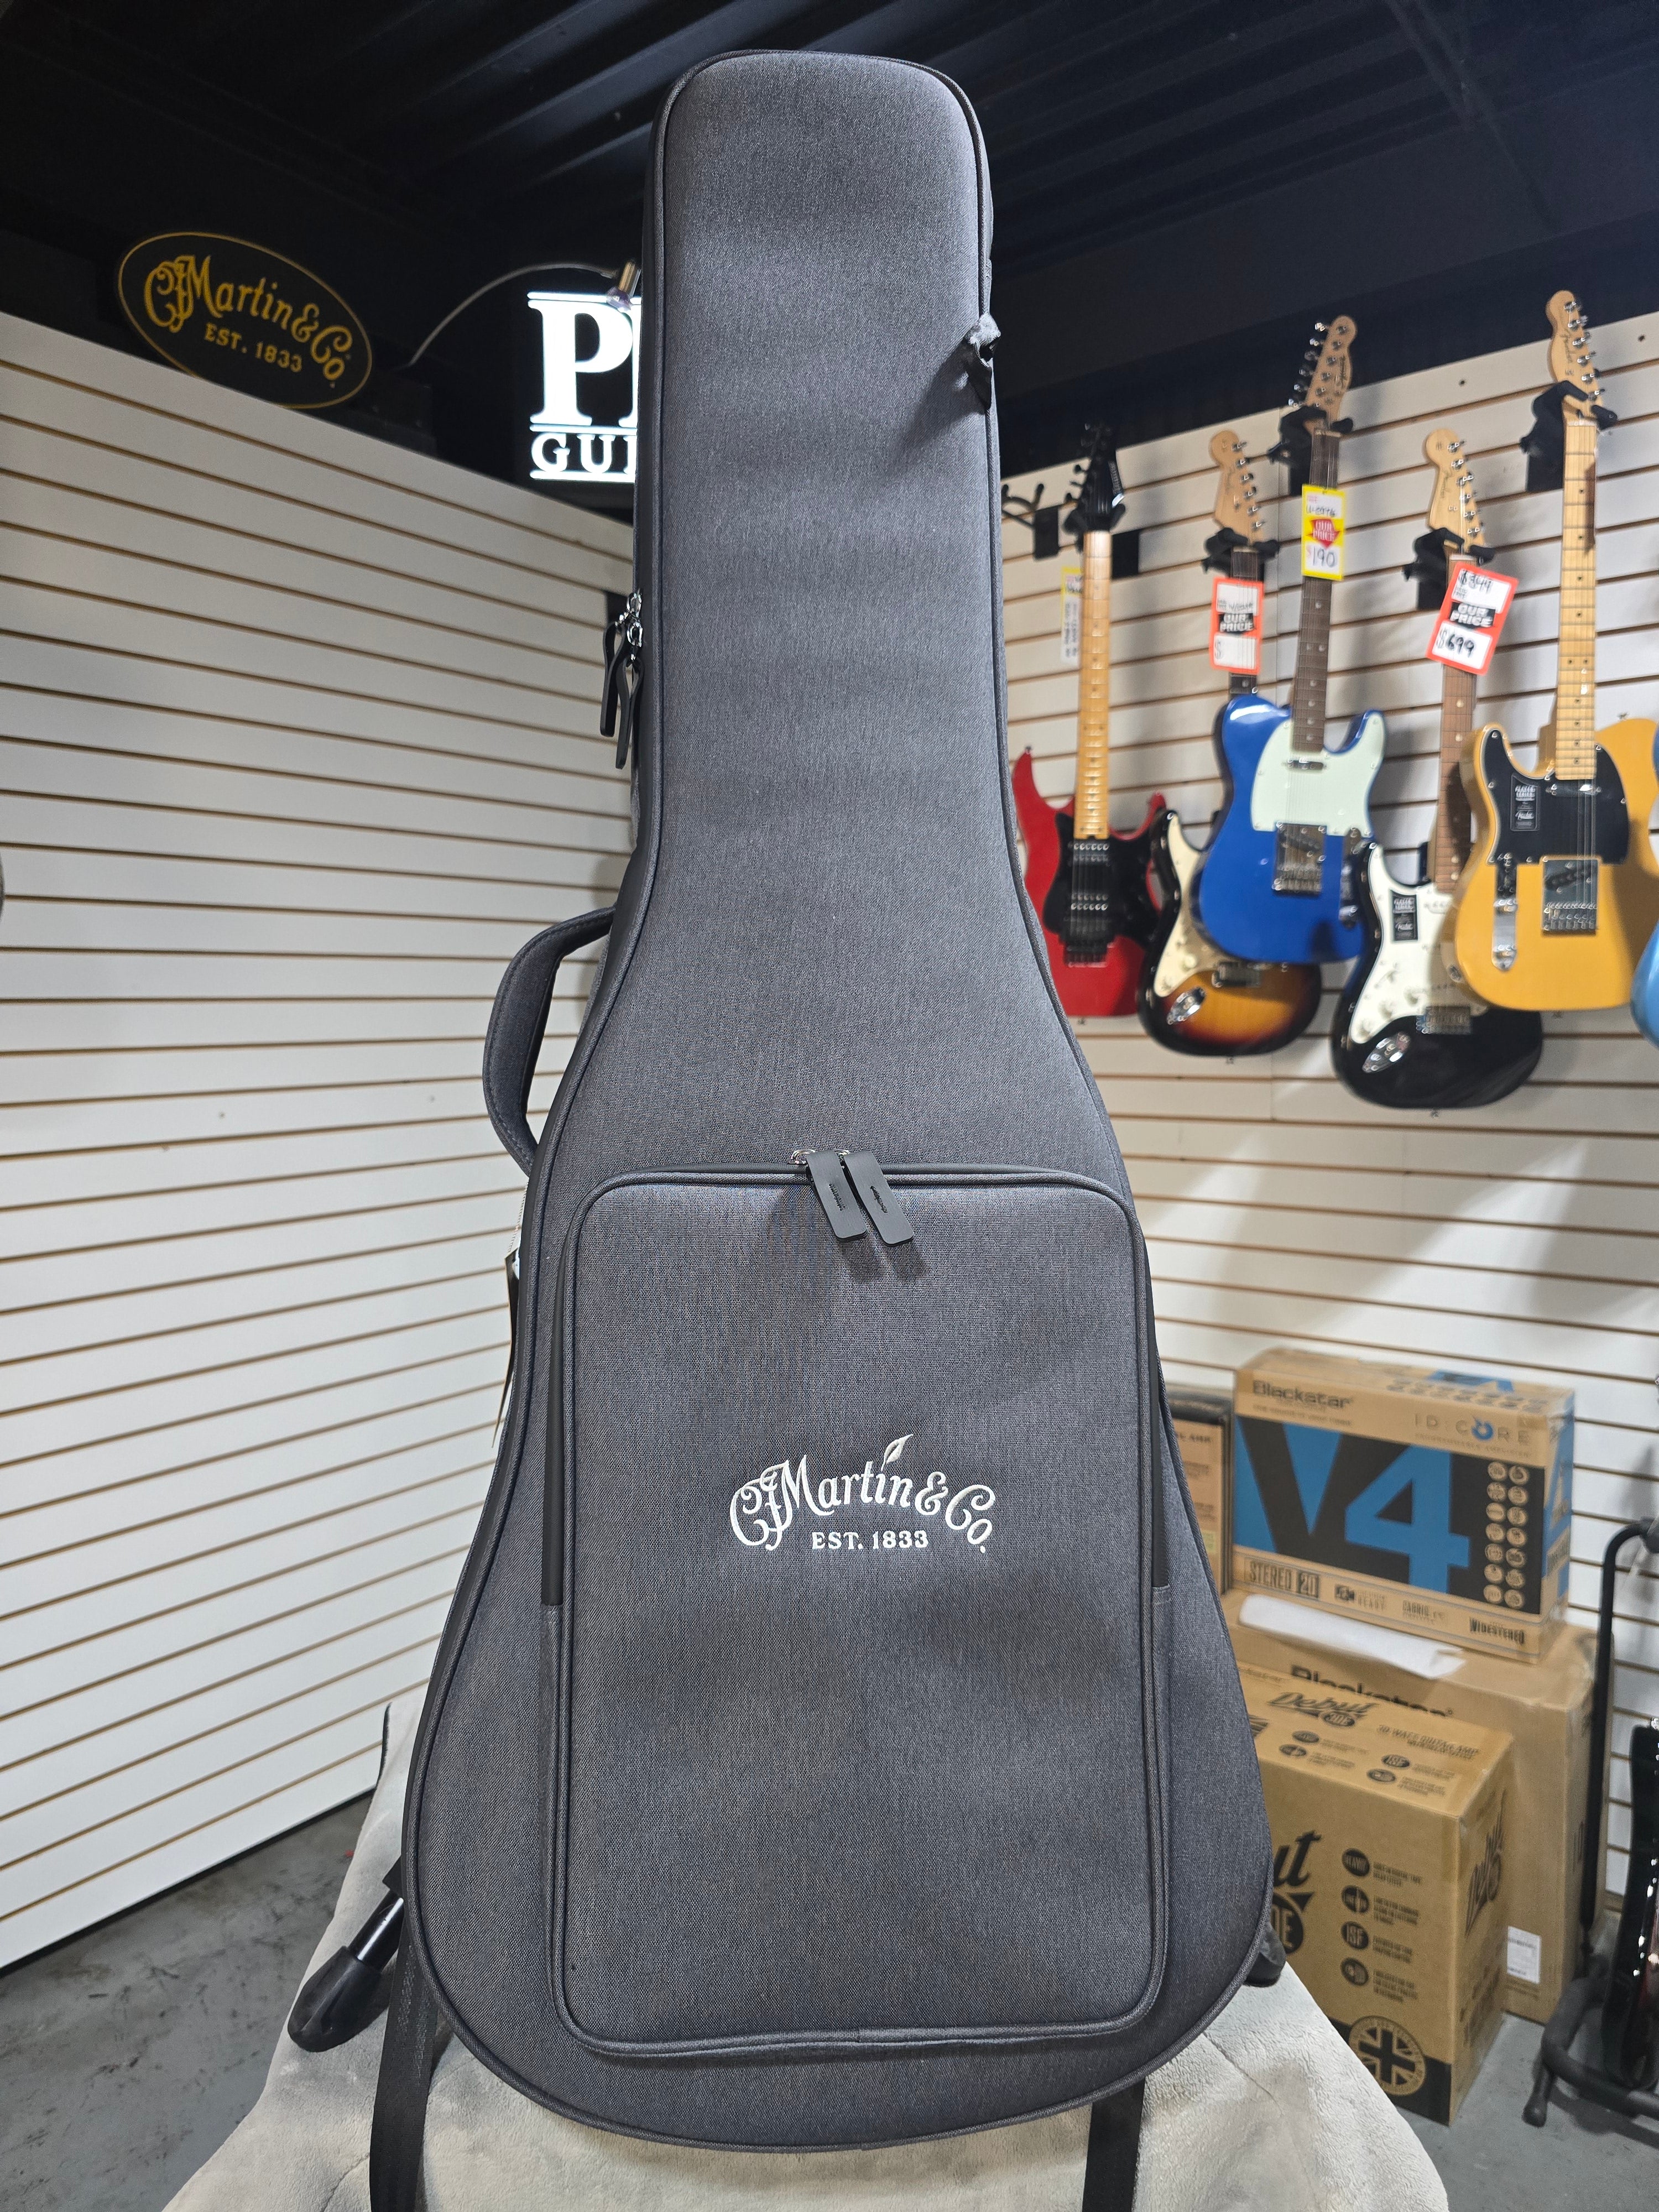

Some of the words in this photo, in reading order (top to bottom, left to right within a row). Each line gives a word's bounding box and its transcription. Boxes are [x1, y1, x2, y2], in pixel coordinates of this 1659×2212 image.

[204, 322, 247, 353] EST.
[255, 342, 302, 373] 1833
[1315, 519, 1332, 532] OUR
[1312, 529, 1335, 542] PRICE
[1223, 613, 1246, 624] OUR
[1449, 609, 1493, 628] PRICE
[1458, 603, 1489, 618] OUR
[1219, 620, 1254, 633] PRICE
[1253, 1379, 1353, 1409] Blackstar
[812, 1531, 863, 1551] EST.
[872, 1530, 929, 1550] 1833
[1267, 1692, 1380, 1714] Debut
[1346, 1923, 1364, 1947] ISF
